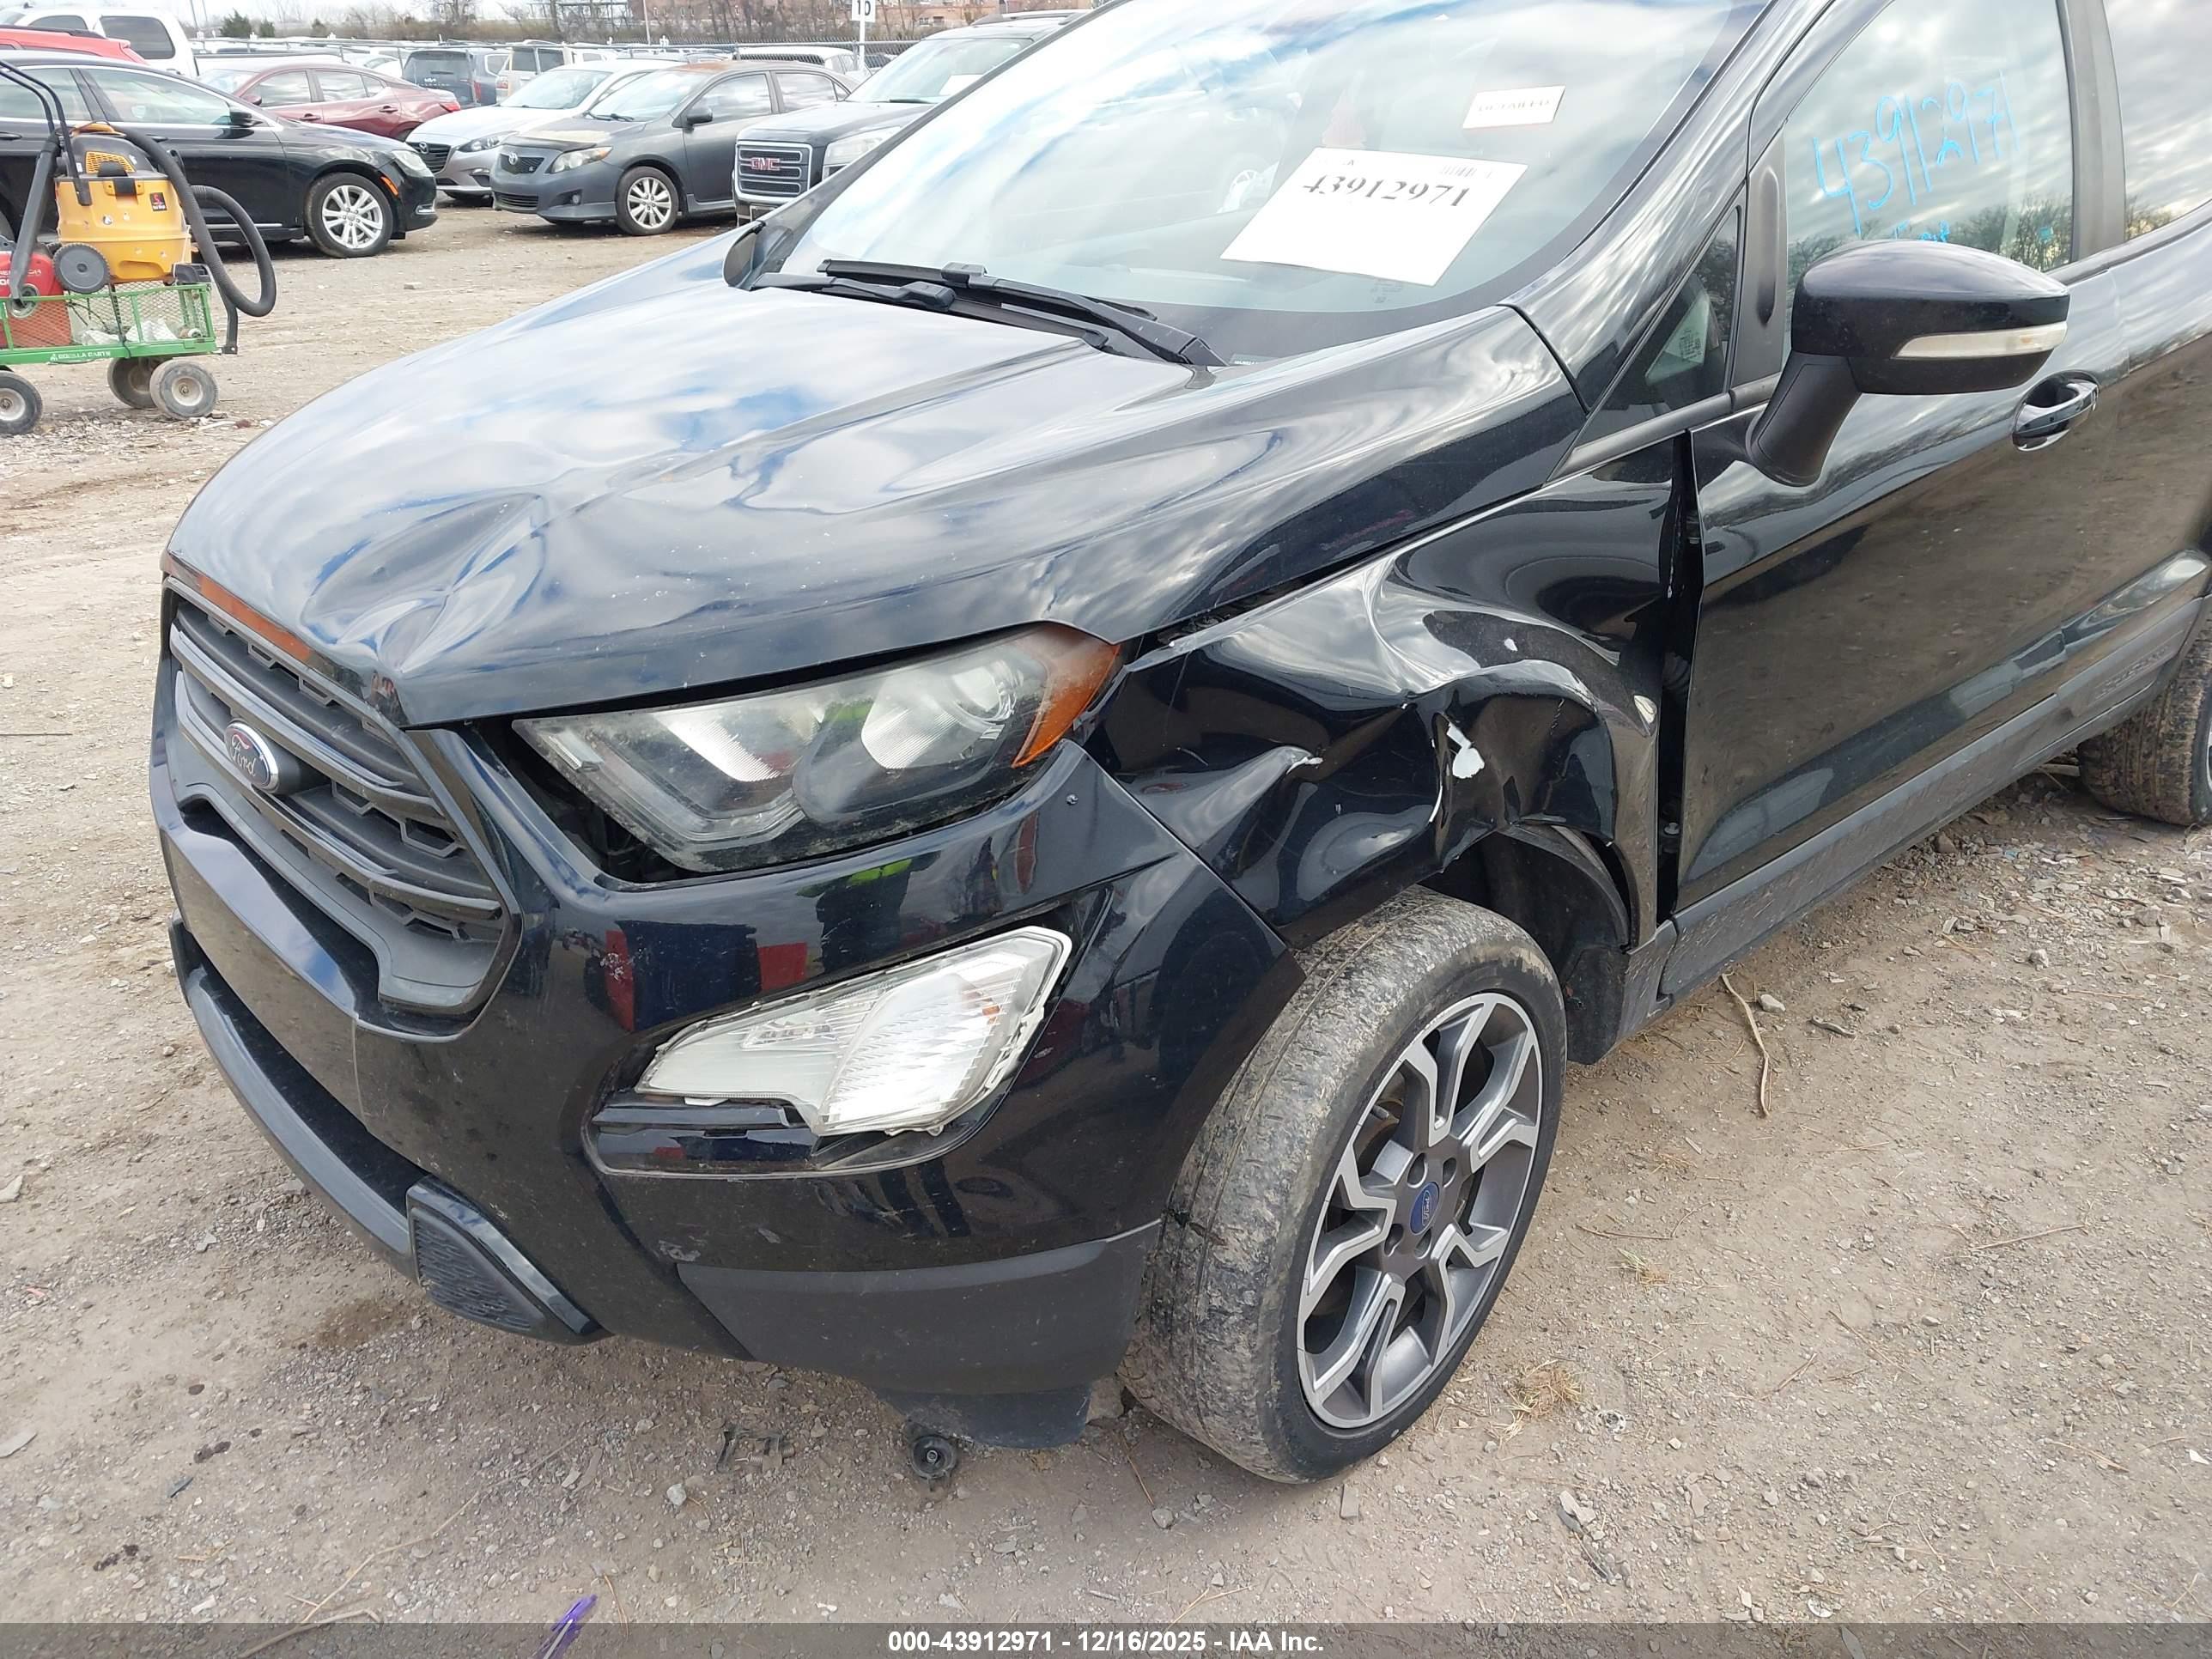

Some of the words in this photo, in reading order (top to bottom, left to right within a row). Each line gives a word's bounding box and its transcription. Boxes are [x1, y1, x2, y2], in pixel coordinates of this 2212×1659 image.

[857, 0, 872, 15] 10
[751, 157, 781, 171] GMC
[1813, 68, 2020, 237] 43912971
[1303, 174, 1470, 207] 43912971
[230, 734, 257, 776] Ford
